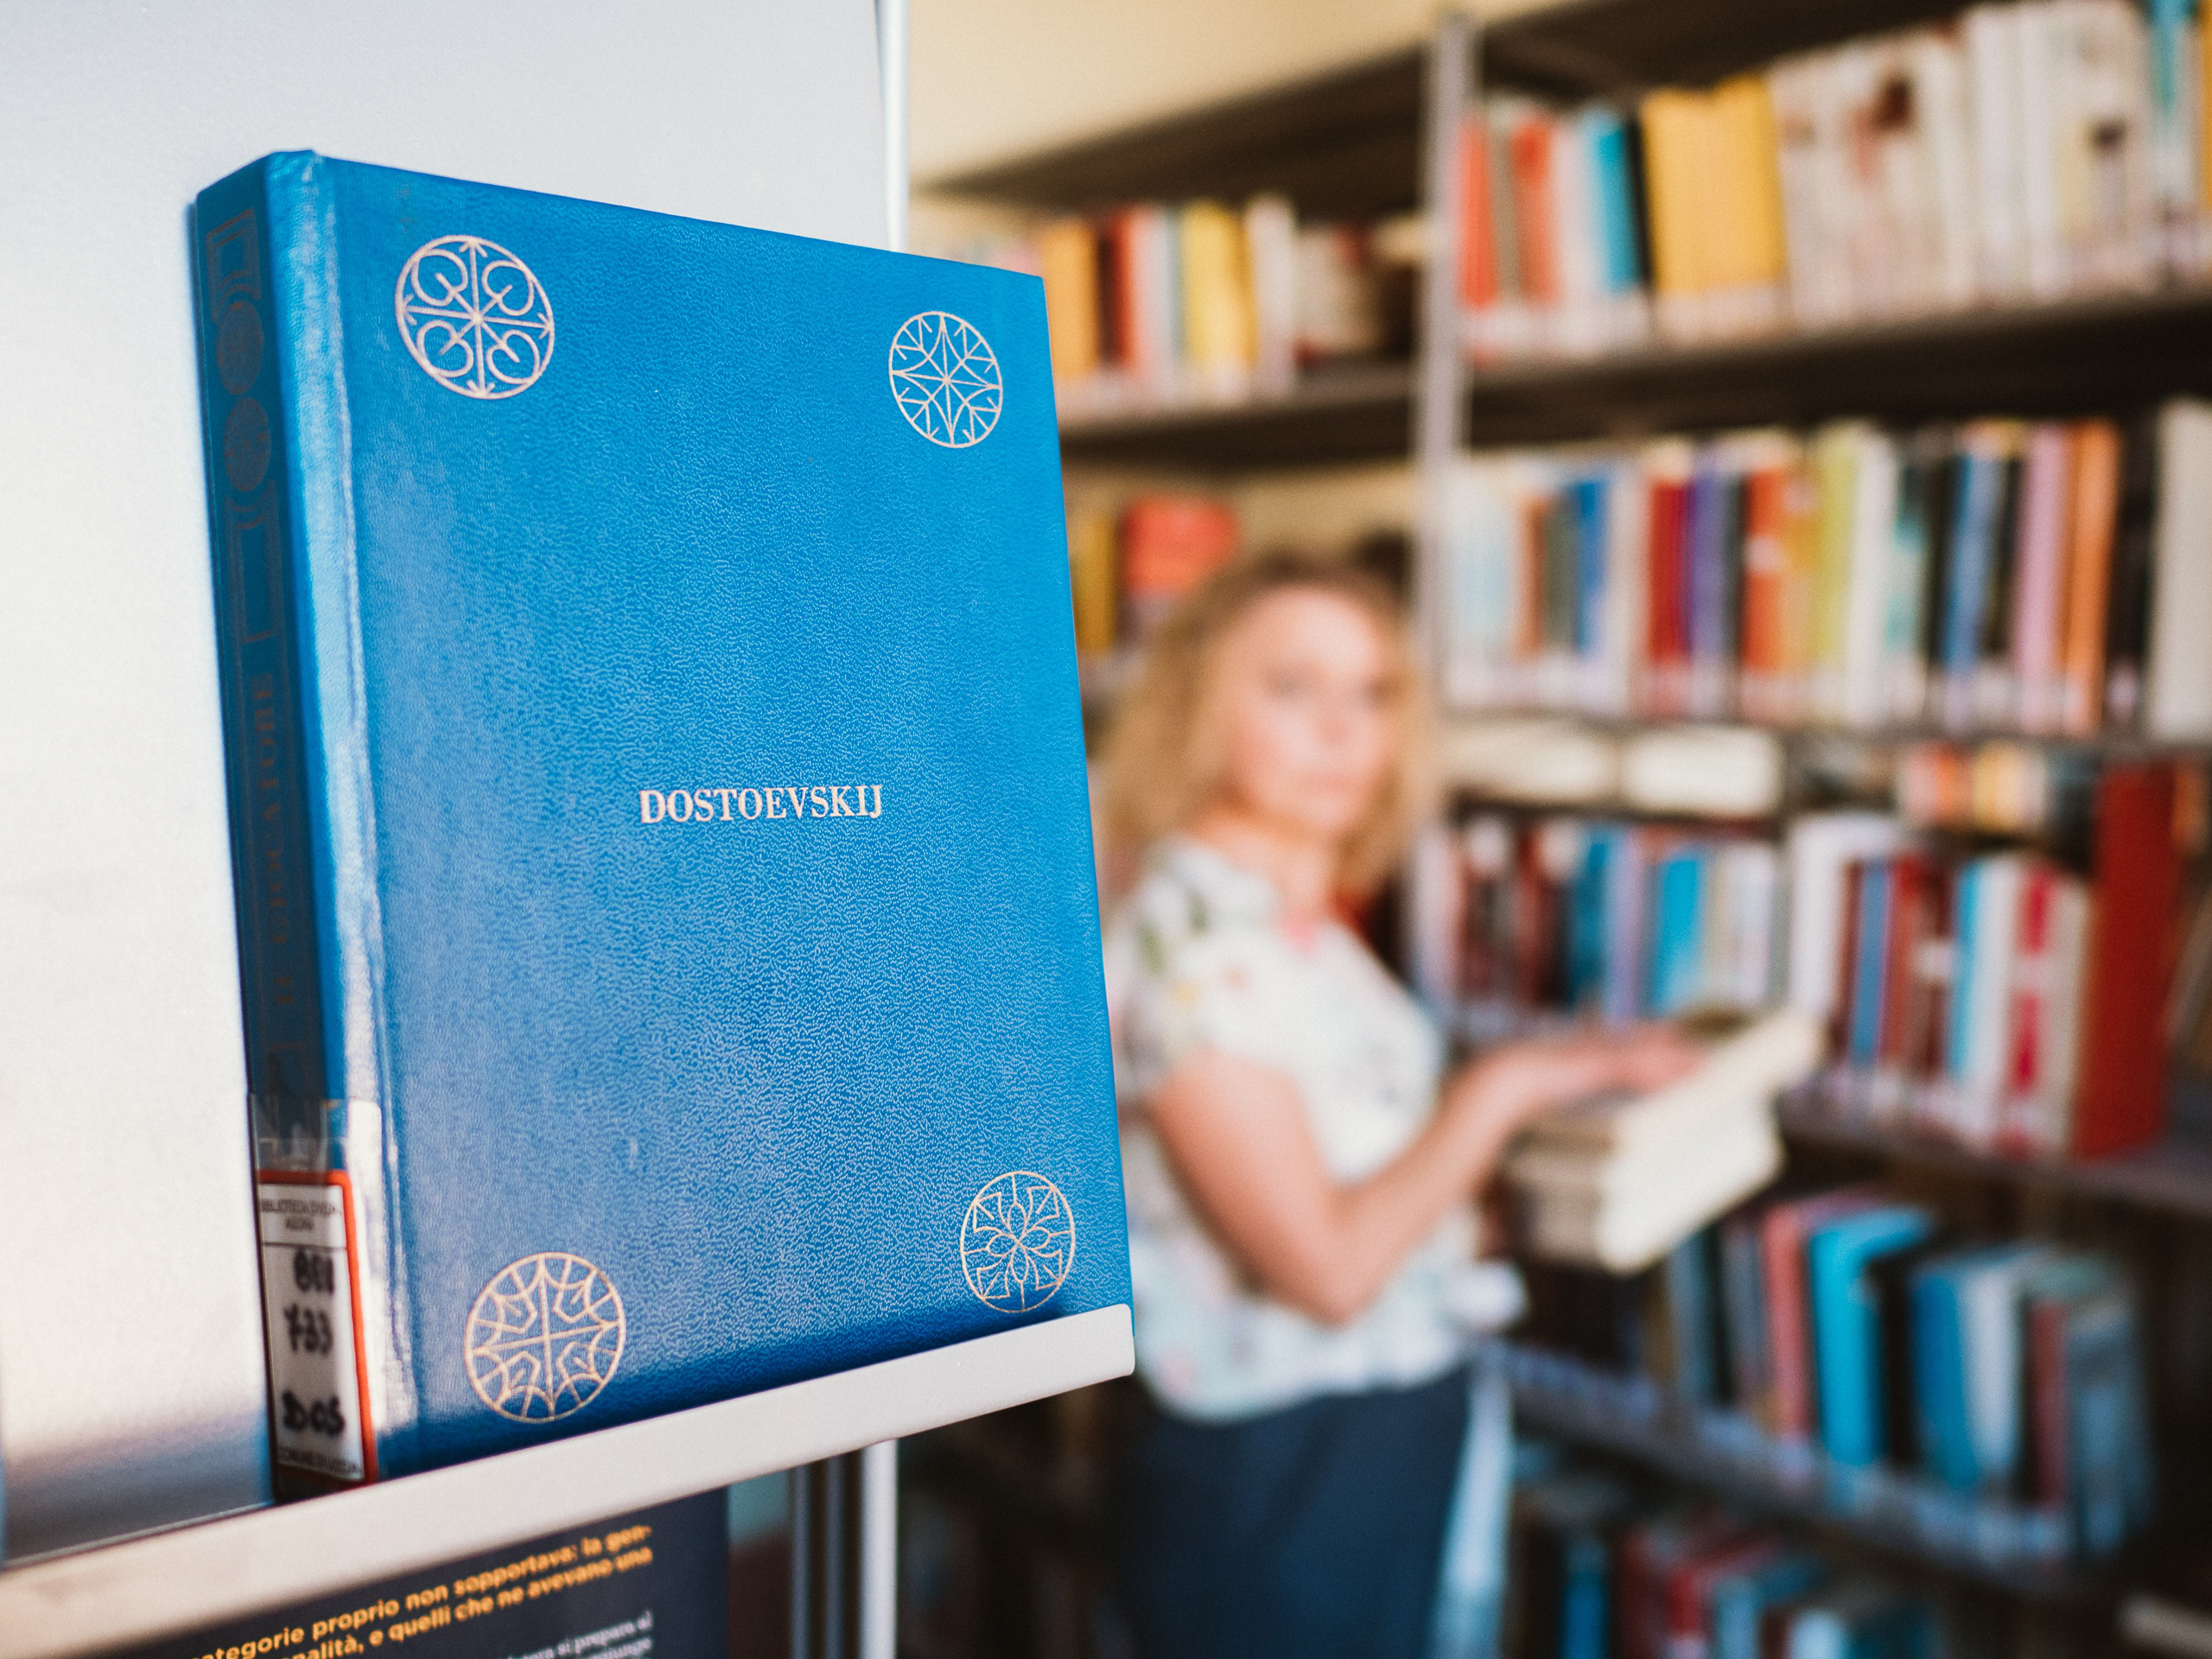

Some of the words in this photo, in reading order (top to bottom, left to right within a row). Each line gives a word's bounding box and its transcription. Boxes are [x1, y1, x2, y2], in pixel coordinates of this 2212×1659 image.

[639, 785, 882, 823] DOSTOEVSKIJ
[312, 1599, 400, 1642] proprio
[405, 1585, 448, 1611] non
[581, 1537, 602, 1556] la
[368, 1630, 384, 1647] e
[388, 1604, 451, 1643] quelli
[454, 1596, 494, 1622] che
[497, 1586, 524, 1609] ne
[527, 1559, 613, 1599] avevano
[614, 1547, 653, 1571] una
